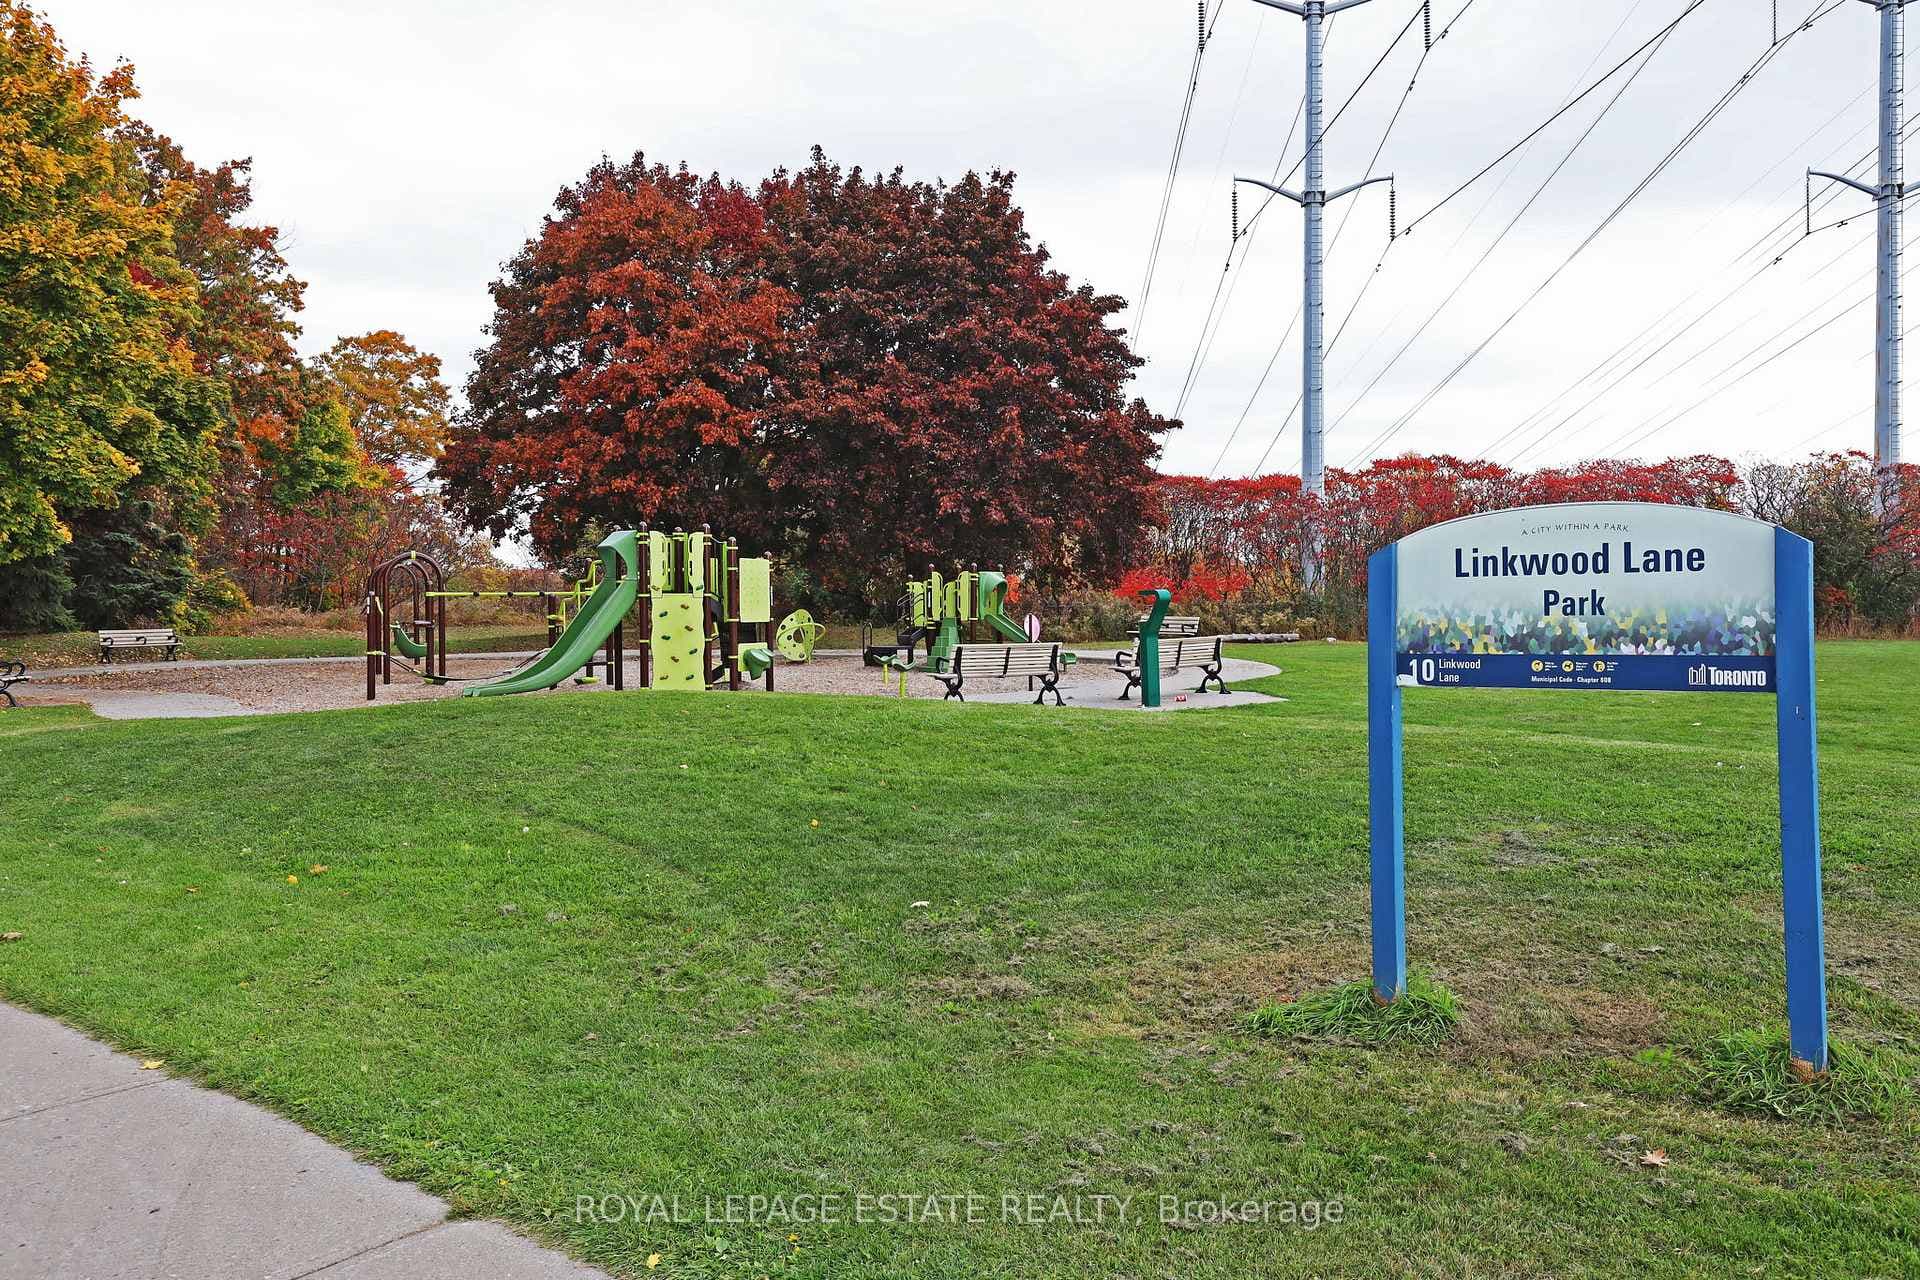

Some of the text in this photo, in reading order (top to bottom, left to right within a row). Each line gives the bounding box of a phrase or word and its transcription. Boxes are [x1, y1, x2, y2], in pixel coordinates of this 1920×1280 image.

[1521, 521, 1630, 536] A CITY WITHIN A PARK
[1455, 541, 1706, 578] Linkwood Lane
[1543, 589, 1606, 617] Park
[1409, 658, 1435, 682] 10
[1439, 658, 1481, 669] Linkwood
[1439, 672, 1460, 683] Lane
[1531, 675, 1558, 684] Municipal
[1708, 666, 1767, 686] TORONTO
